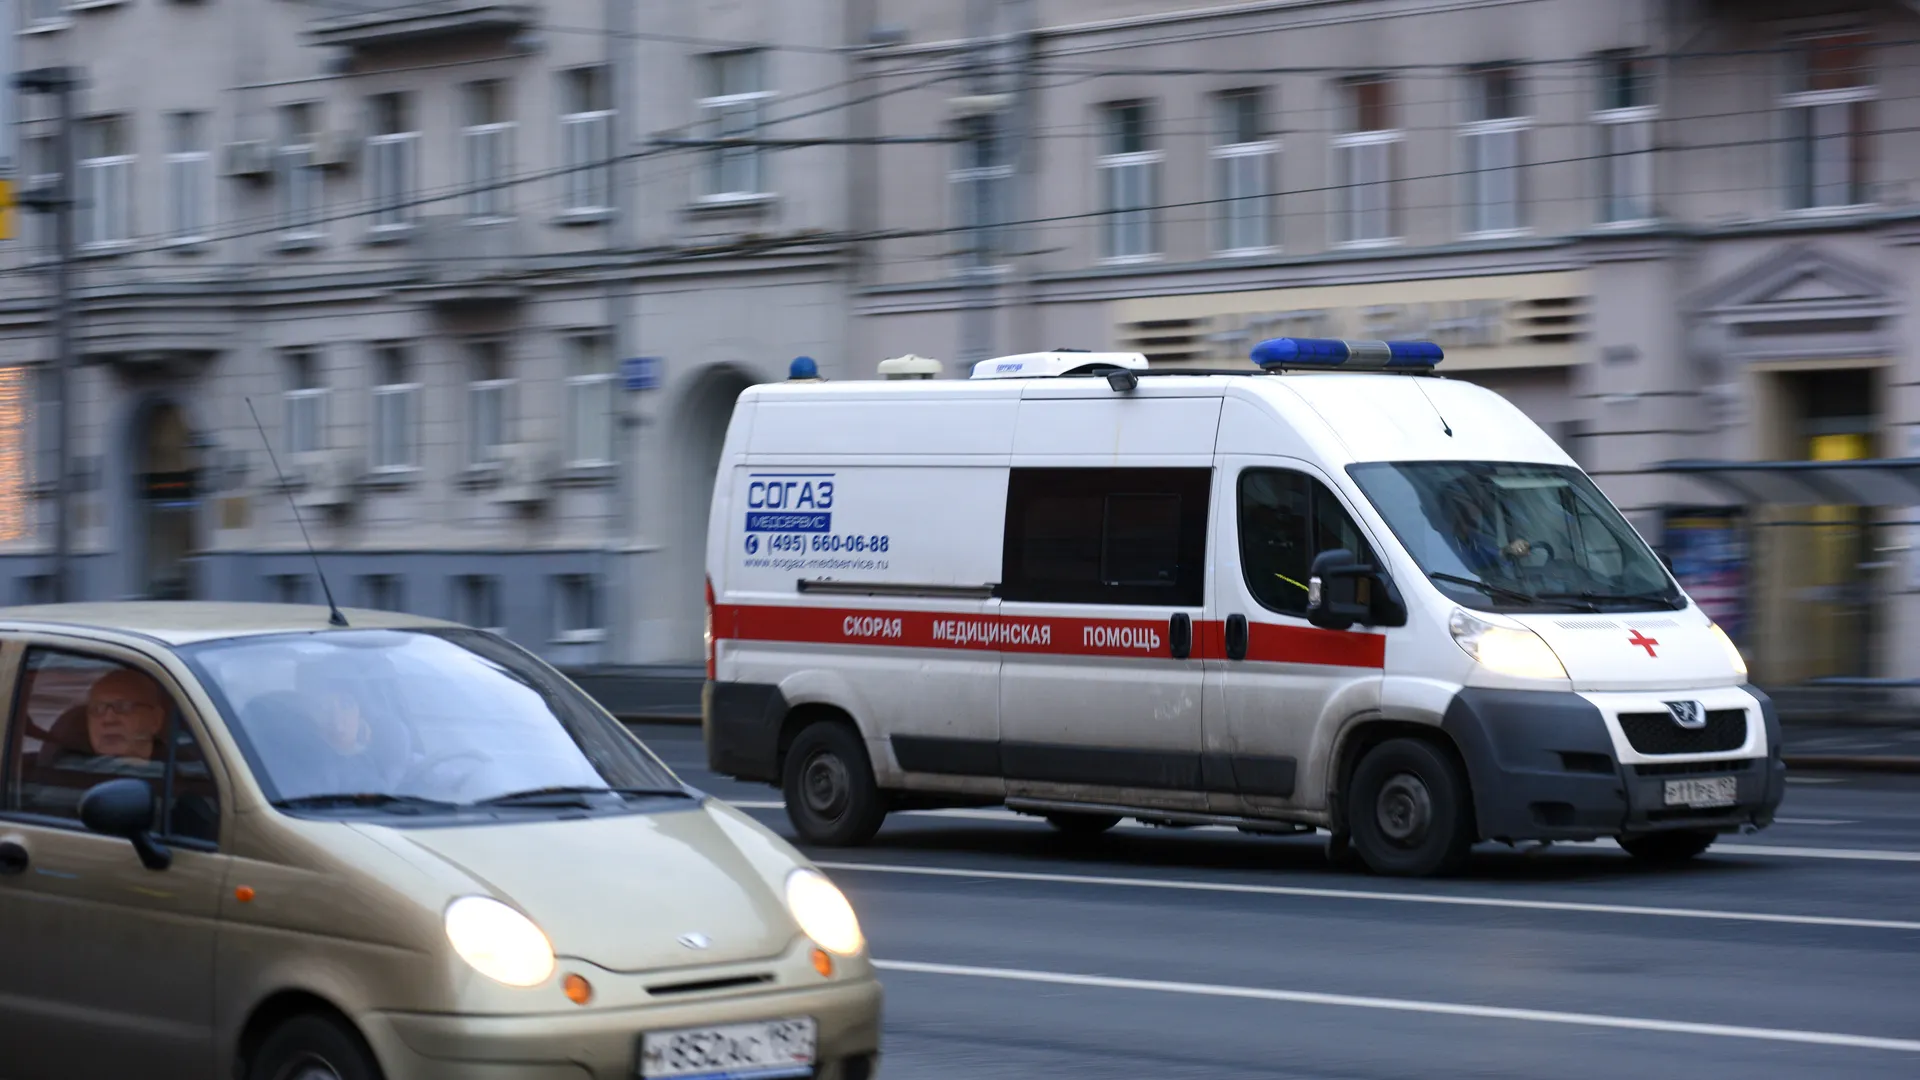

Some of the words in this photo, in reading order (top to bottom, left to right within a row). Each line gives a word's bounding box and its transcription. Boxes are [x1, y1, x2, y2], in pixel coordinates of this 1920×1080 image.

[748, 481, 834, 510] СОГАЗ
[750, 515, 825, 531] МЕДСЕРВИС
[767, 534, 807, 555] (495)
[811, 535, 890, 553] 660-06-88
[744, 557, 889, 572] www.sogaz-medservice.ru
[842, 615, 902, 638] СКОРАЯ
[932, 619, 1051, 646] МЕДИЦИНСКАЯ
[1083, 625, 1161, 652] ПОМОЩЬ
